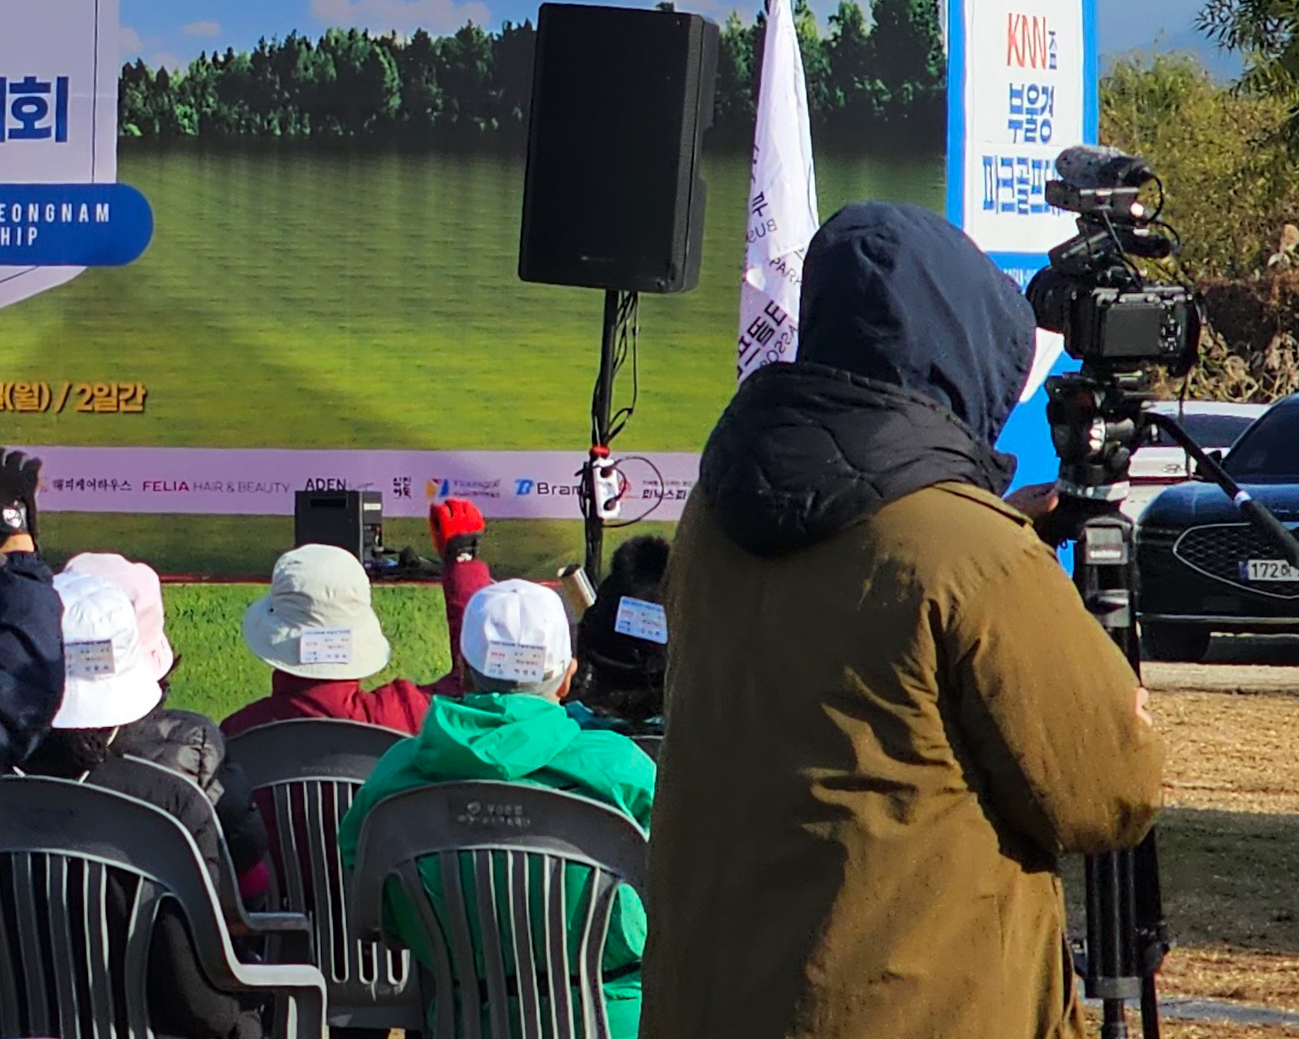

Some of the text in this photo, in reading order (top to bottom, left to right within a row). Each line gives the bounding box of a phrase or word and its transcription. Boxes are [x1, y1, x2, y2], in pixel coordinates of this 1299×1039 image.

[1007, 82, 1055, 145] 부울경
[75, 382, 147, 414] 2일간
[142, 480, 189, 492] FELIA
[193, 480, 223, 492] HAIR
[238, 481, 291, 493] BEAUTY
[305, 477, 347, 492] ADEN
